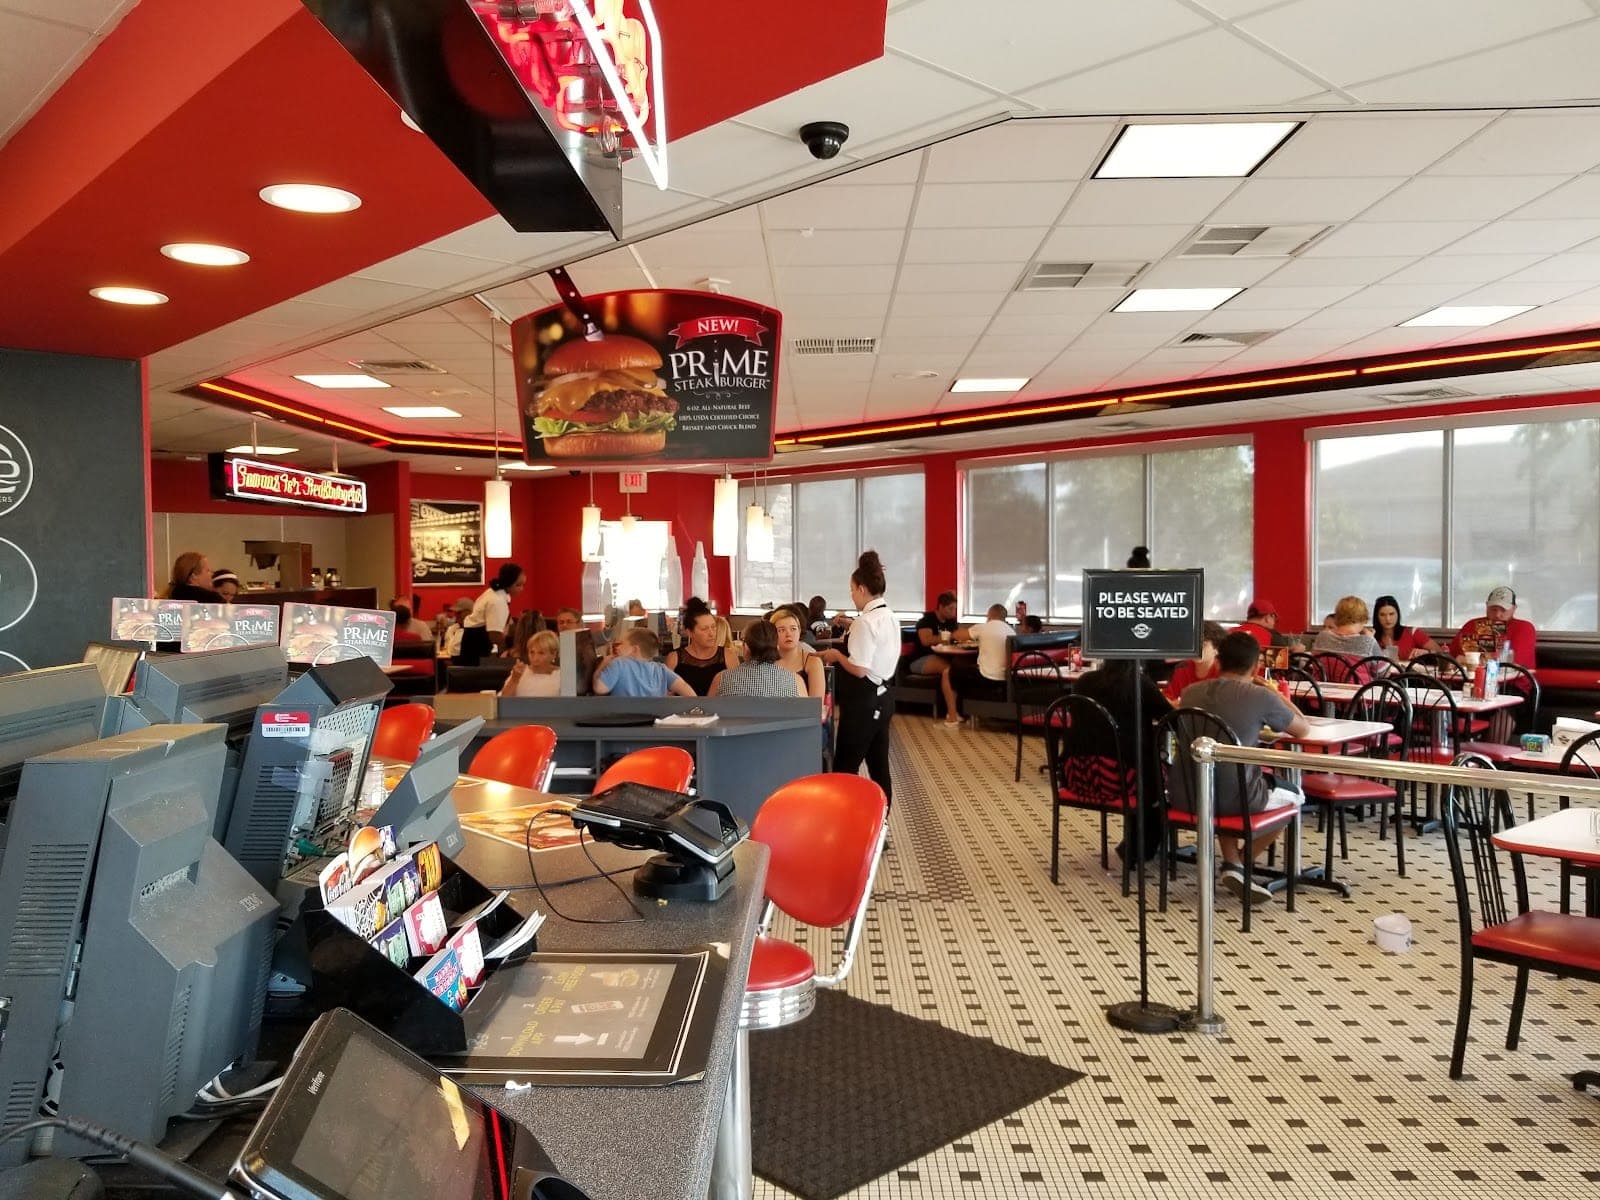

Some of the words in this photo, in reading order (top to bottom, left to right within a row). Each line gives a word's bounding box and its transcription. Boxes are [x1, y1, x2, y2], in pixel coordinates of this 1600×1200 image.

[697, 319, 739, 333] NEW!
[624, 473, 641, 487] EXIT
[1099, 592, 1149, 604] PLEASE
[1151, 592, 1187, 604] WAIT
[1096, 607, 1115, 618] TO
[1117, 607, 1135, 618] BE
[1137, 607, 1189, 618] SEATED
[507, 1020, 539, 1056] DOWNLOAD
